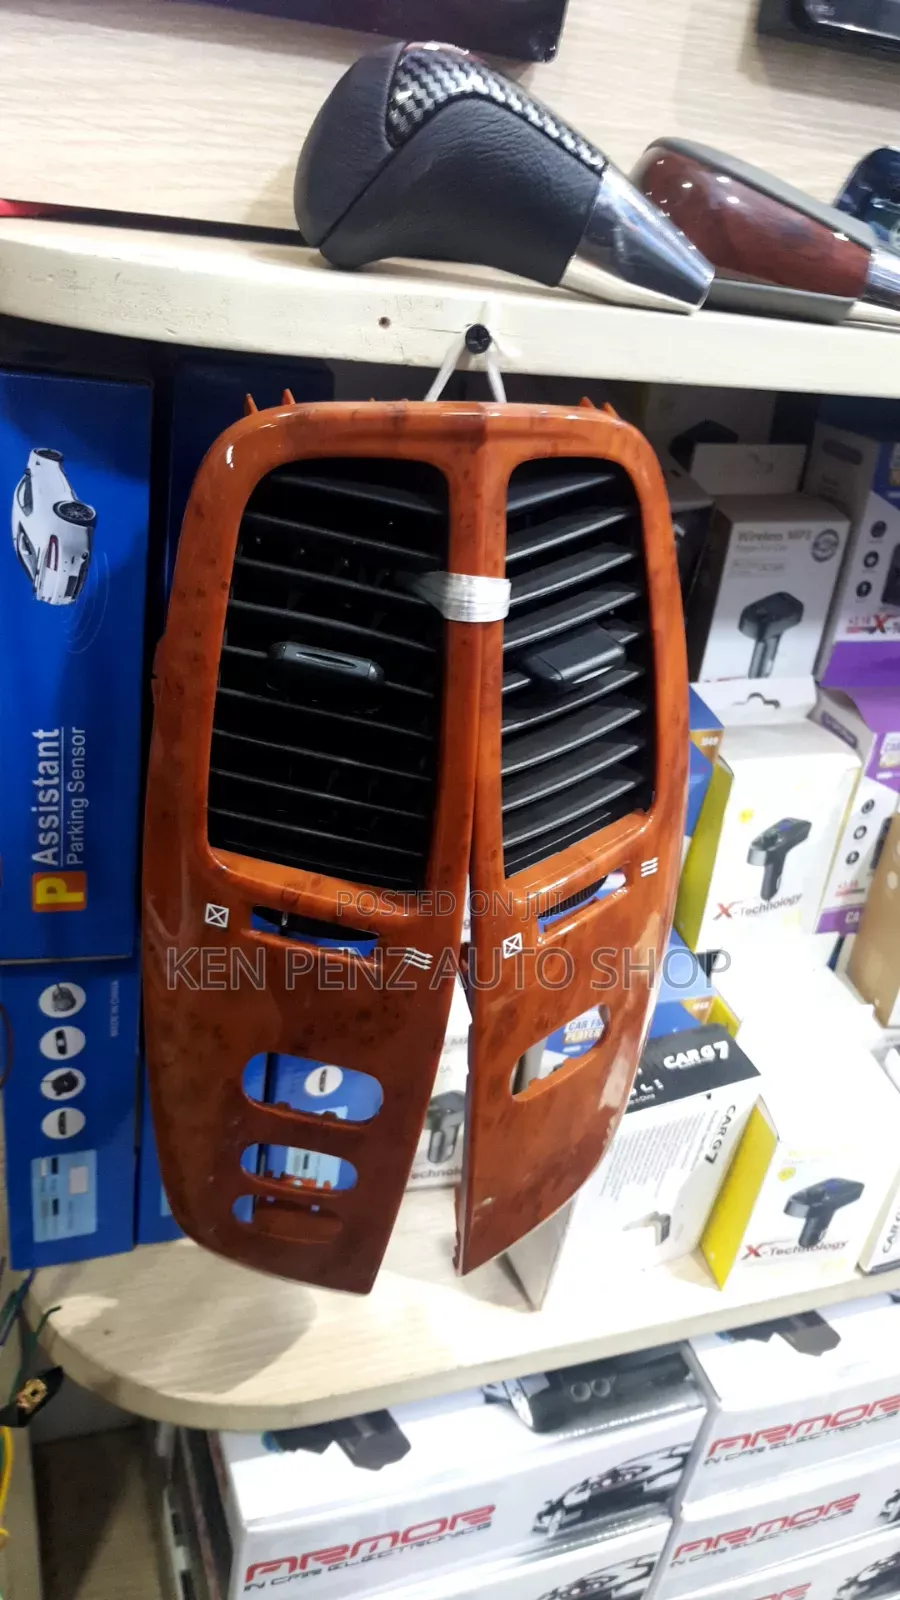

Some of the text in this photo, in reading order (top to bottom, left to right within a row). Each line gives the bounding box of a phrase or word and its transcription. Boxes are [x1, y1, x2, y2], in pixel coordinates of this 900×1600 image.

[31, 728, 60, 866] Assistant
[67, 727, 89, 865] Parking Sensor
[35, 877, 84, 905] P
[713, 893, 802, 920] X-Technology
[742, 1239, 848, 1260] X-Technology
[707, 1393, 900, 1457] ARMOR
[725, 1446, 767, 1461] CAR
[244, 1521, 492, 1592] IN CAR ELECTRONICS
[245, 1504, 496, 1584] ARMOR
[672, 1492, 861, 1561] ARMOR
[689, 1546, 728, 1562] CAR
